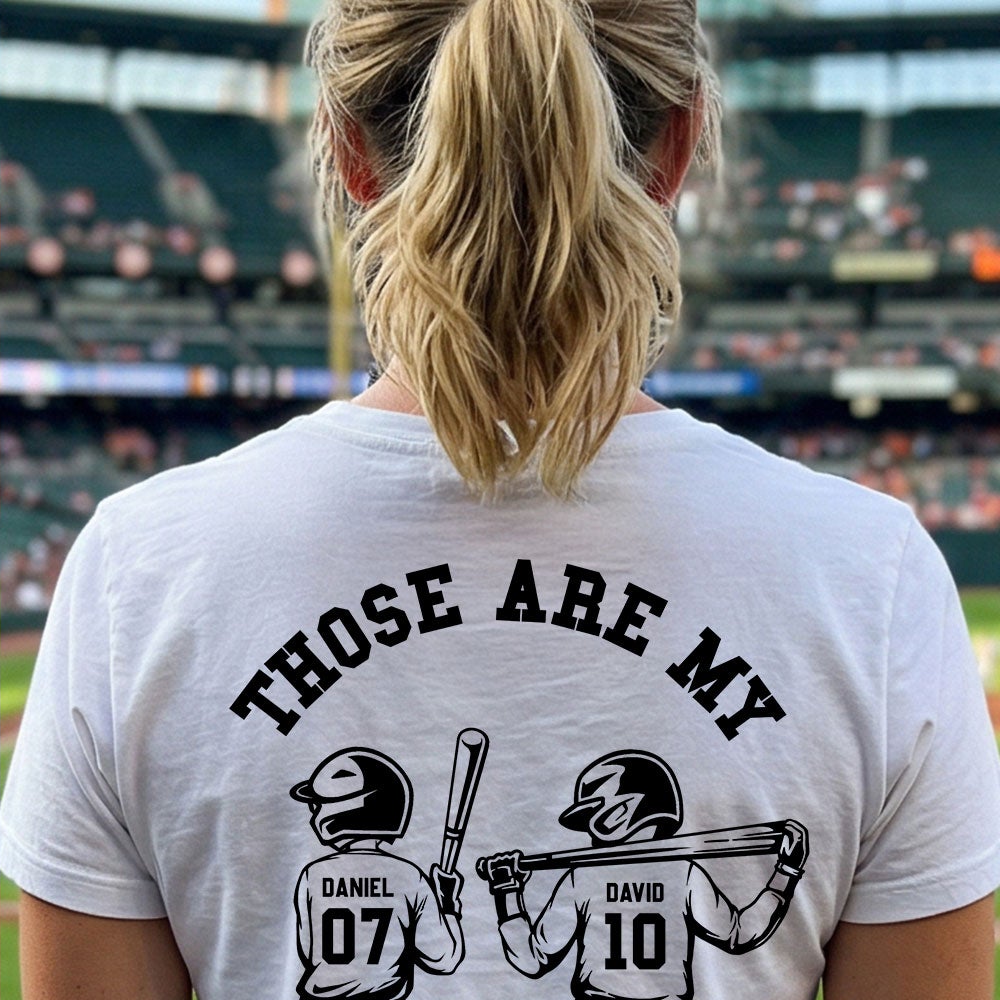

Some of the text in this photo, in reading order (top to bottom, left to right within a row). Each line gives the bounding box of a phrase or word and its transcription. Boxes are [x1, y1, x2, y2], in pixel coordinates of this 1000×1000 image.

[230, 559, 786, 741] THOSE ARE MY
[322, 877, 395, 898] DANIEL
[606, 882, 665, 903] DAVID
[321, 907, 394, 965] 07
[604, 912, 666, 970] 10
